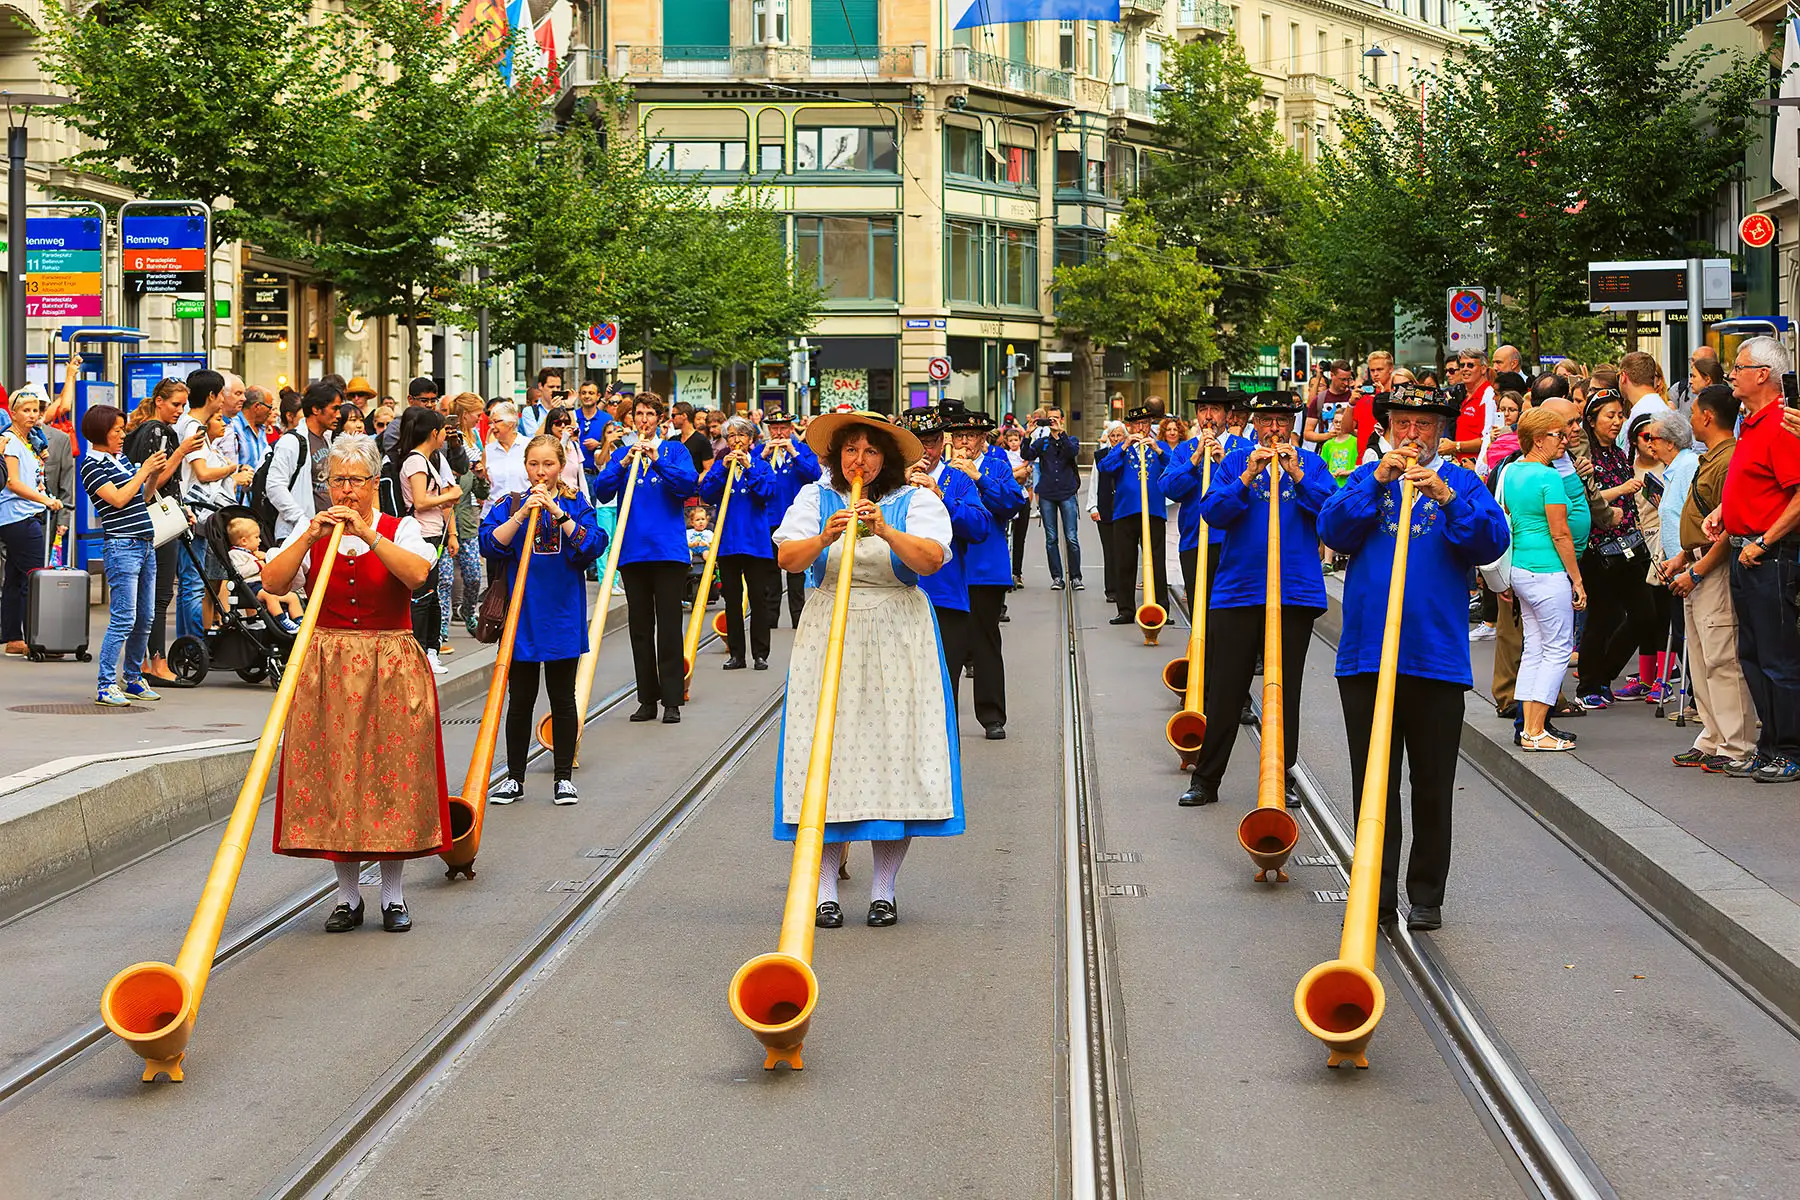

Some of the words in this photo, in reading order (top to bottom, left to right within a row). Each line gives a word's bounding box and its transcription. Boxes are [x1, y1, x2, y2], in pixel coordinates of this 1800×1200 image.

[126, 235, 169, 246] Rennweg
[27, 259, 39, 271] 11
[135, 257, 144, 269] 6
[26, 281, 39, 292] 13
[135, 280, 144, 292] 7
[26, 303, 39, 315] 17
[688, 373, 709, 385] New
[834, 379, 861, 390] SALE
